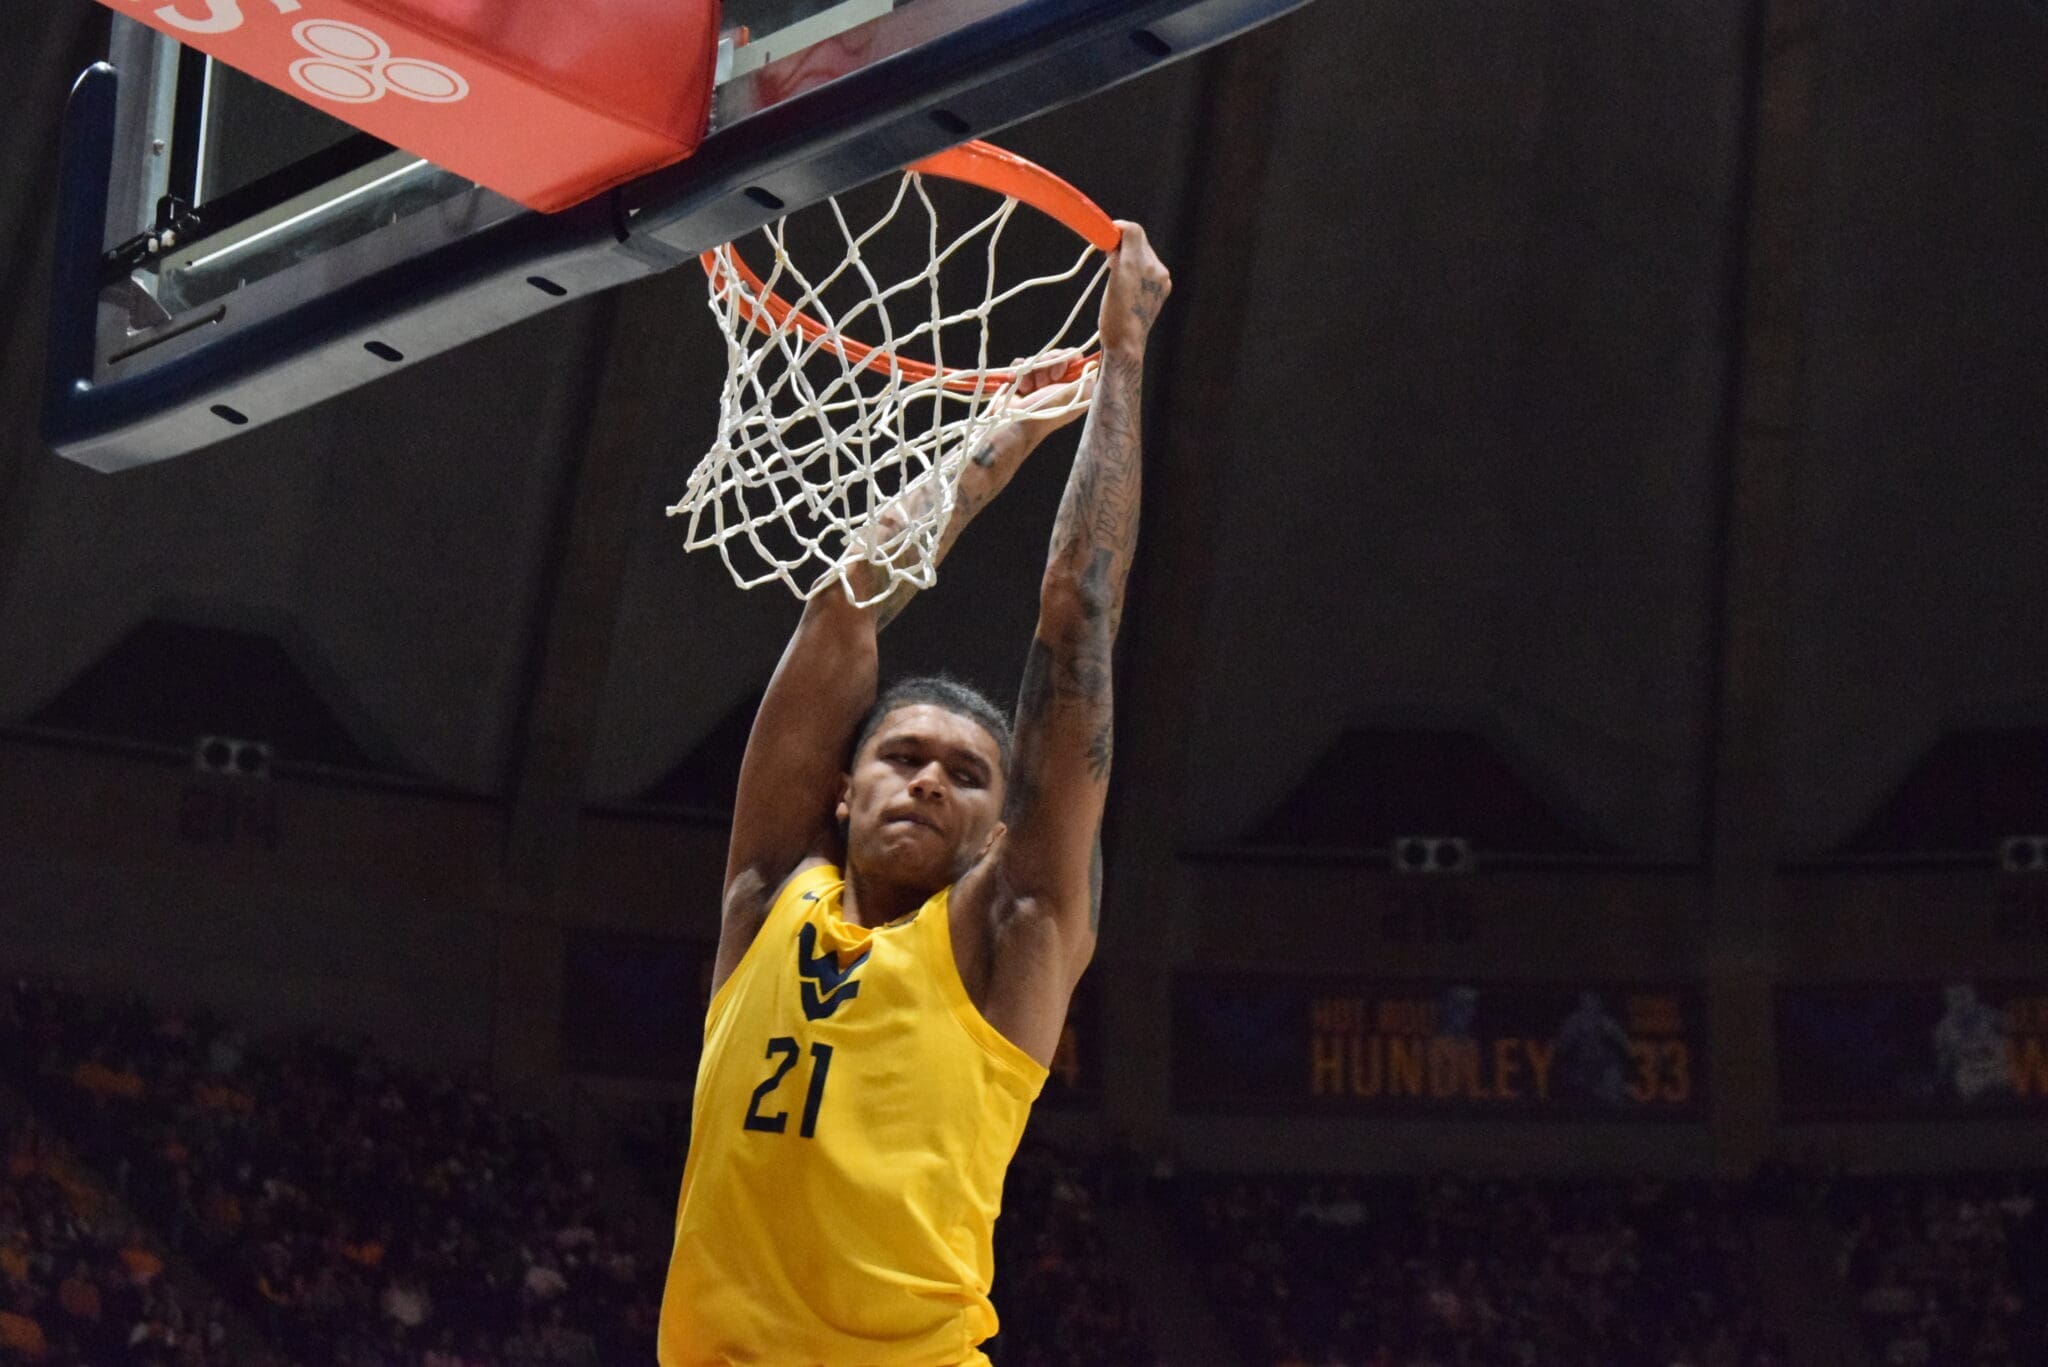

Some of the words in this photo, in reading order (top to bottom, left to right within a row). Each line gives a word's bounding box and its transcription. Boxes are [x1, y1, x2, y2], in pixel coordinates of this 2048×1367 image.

[743, 1036, 834, 1139] 21
[1311, 1035, 1556, 1101] HUNDLEY
[1626, 1038, 1691, 1102] 33
